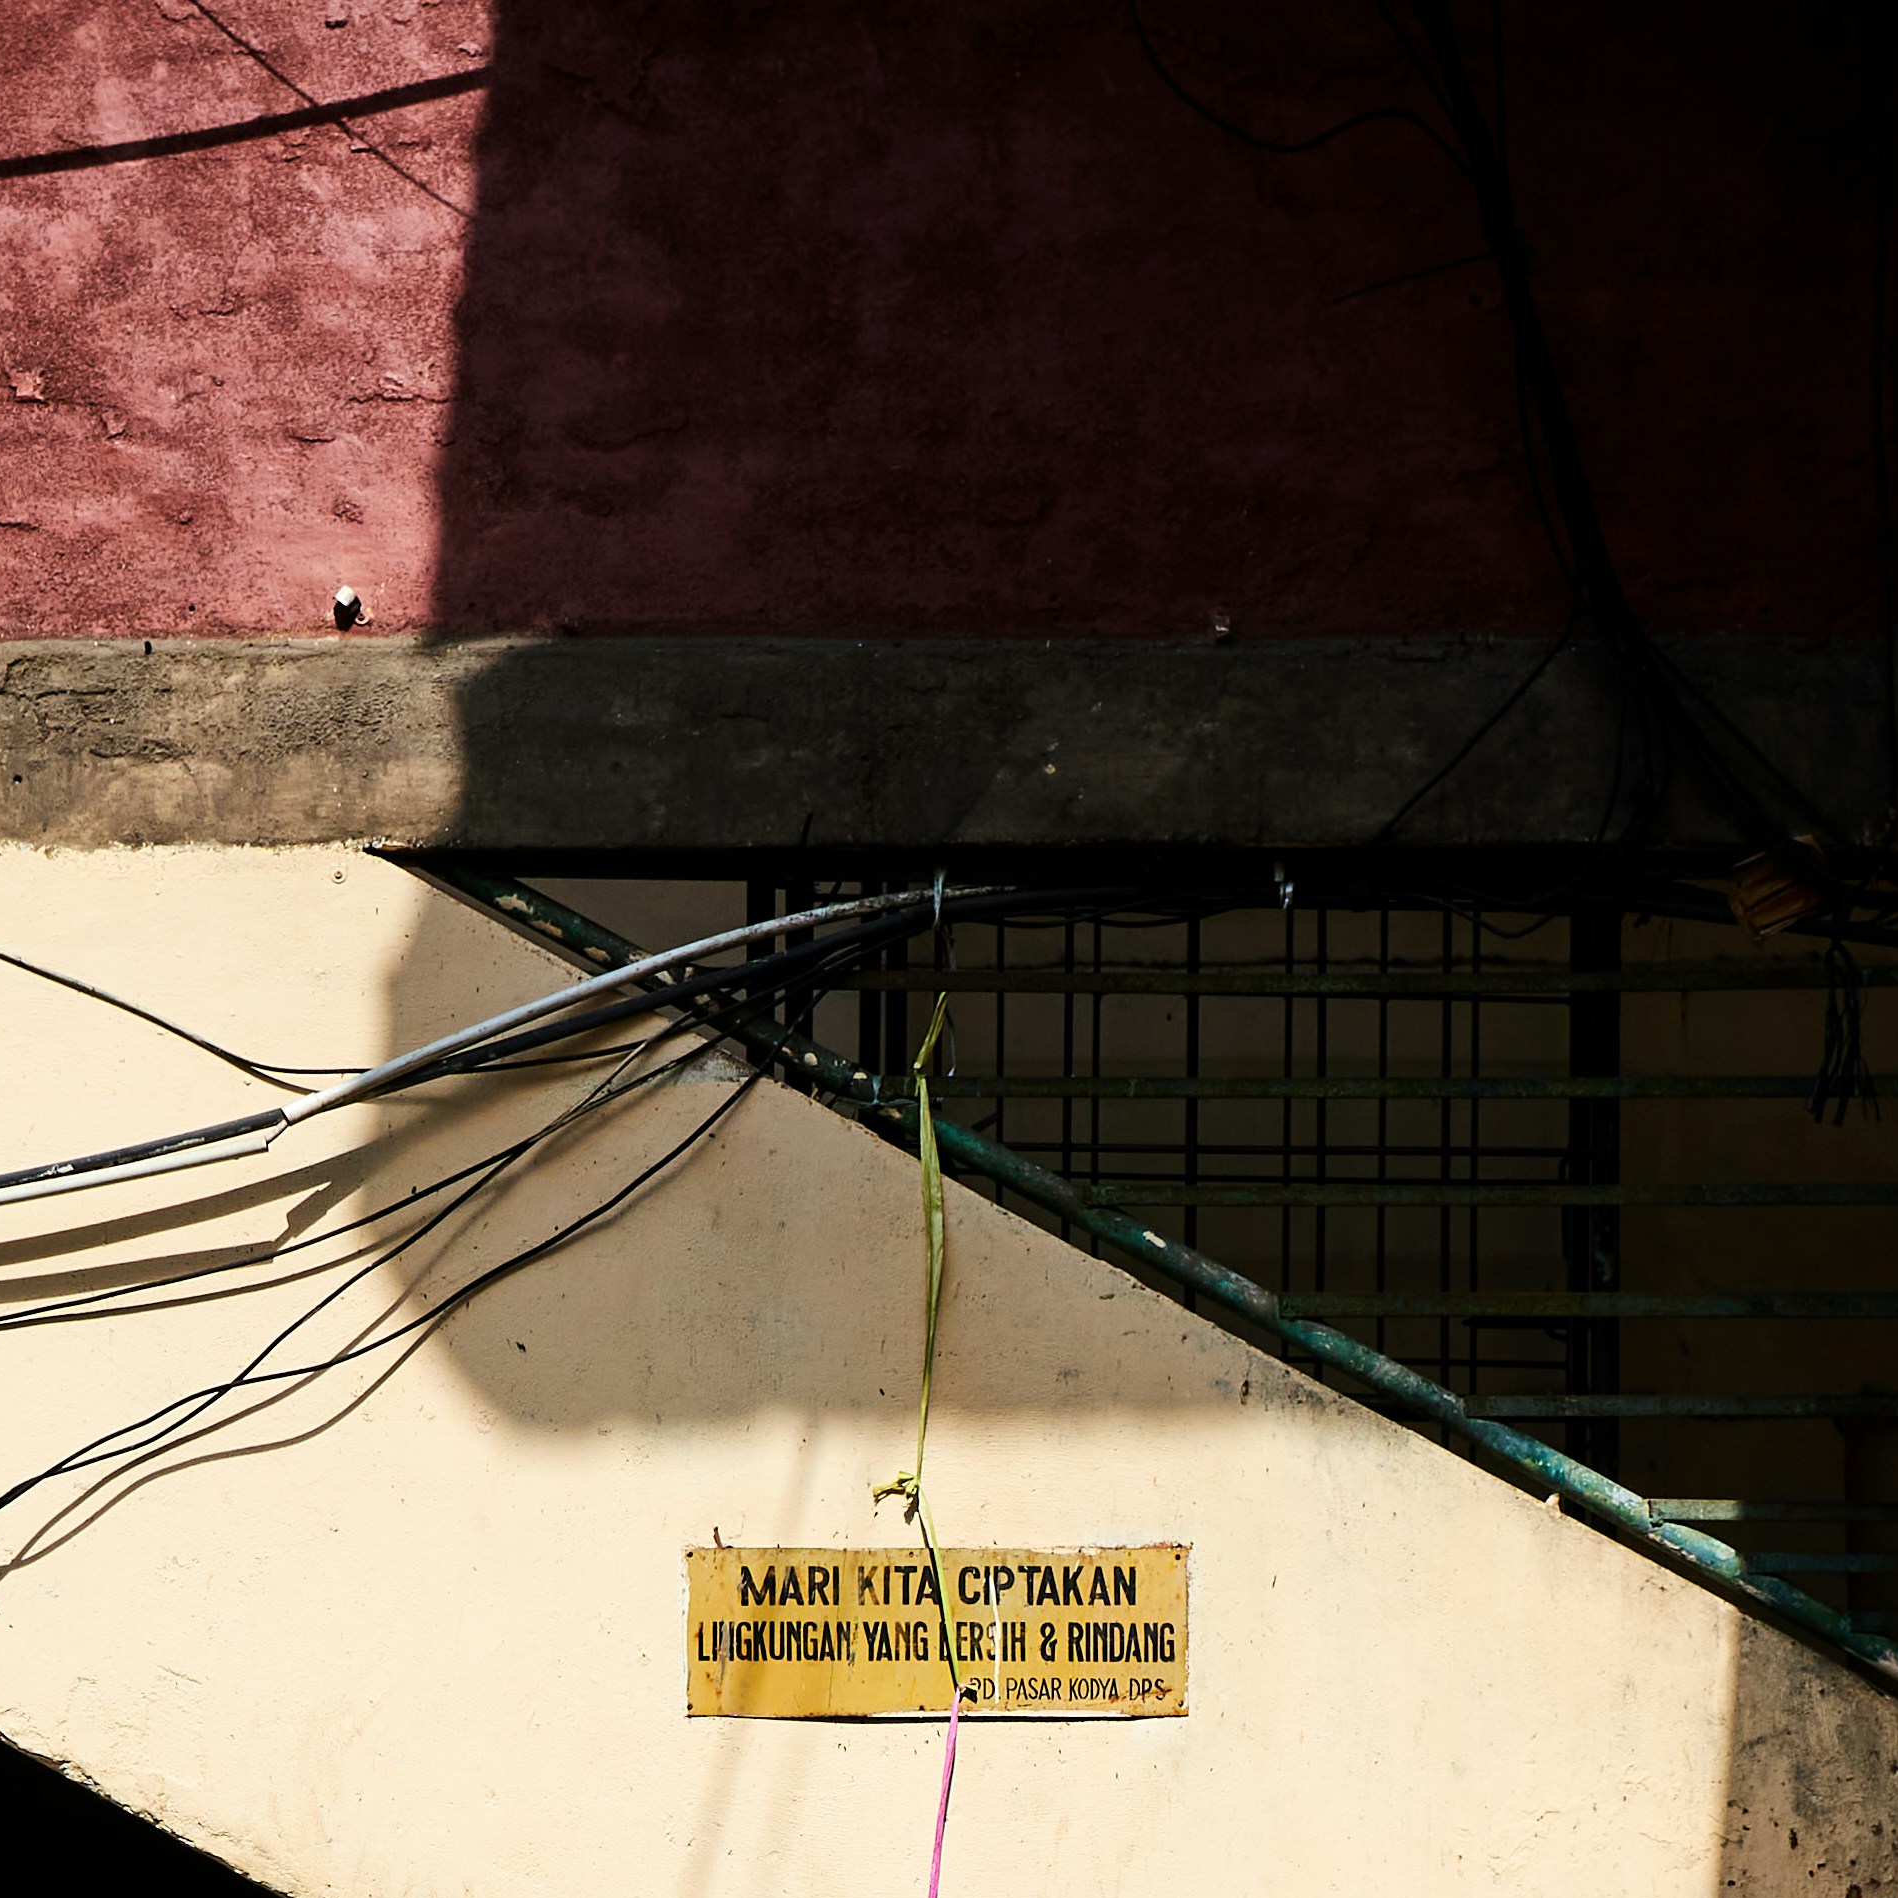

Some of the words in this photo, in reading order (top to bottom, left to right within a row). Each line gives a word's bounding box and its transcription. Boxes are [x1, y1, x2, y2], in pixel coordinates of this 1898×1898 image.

[740, 1565, 841, 1606] MARI
[858, 1565, 941, 1606] KITA
[958, 1565, 1137, 1606] CIPTAKAN
[697, 1621, 851, 1662] LINGKUNGAN
[863, 1621, 929, 1662] YANG
[1040, 1622, 1058, 1663] &
[1068, 1622, 1176, 1663] RINDANG
[1006, 1677, 1062, 1701] PASAR
[1069, 1677, 1119, 1702] KODYA
[1129, 1678, 1166, 1702] DPS
